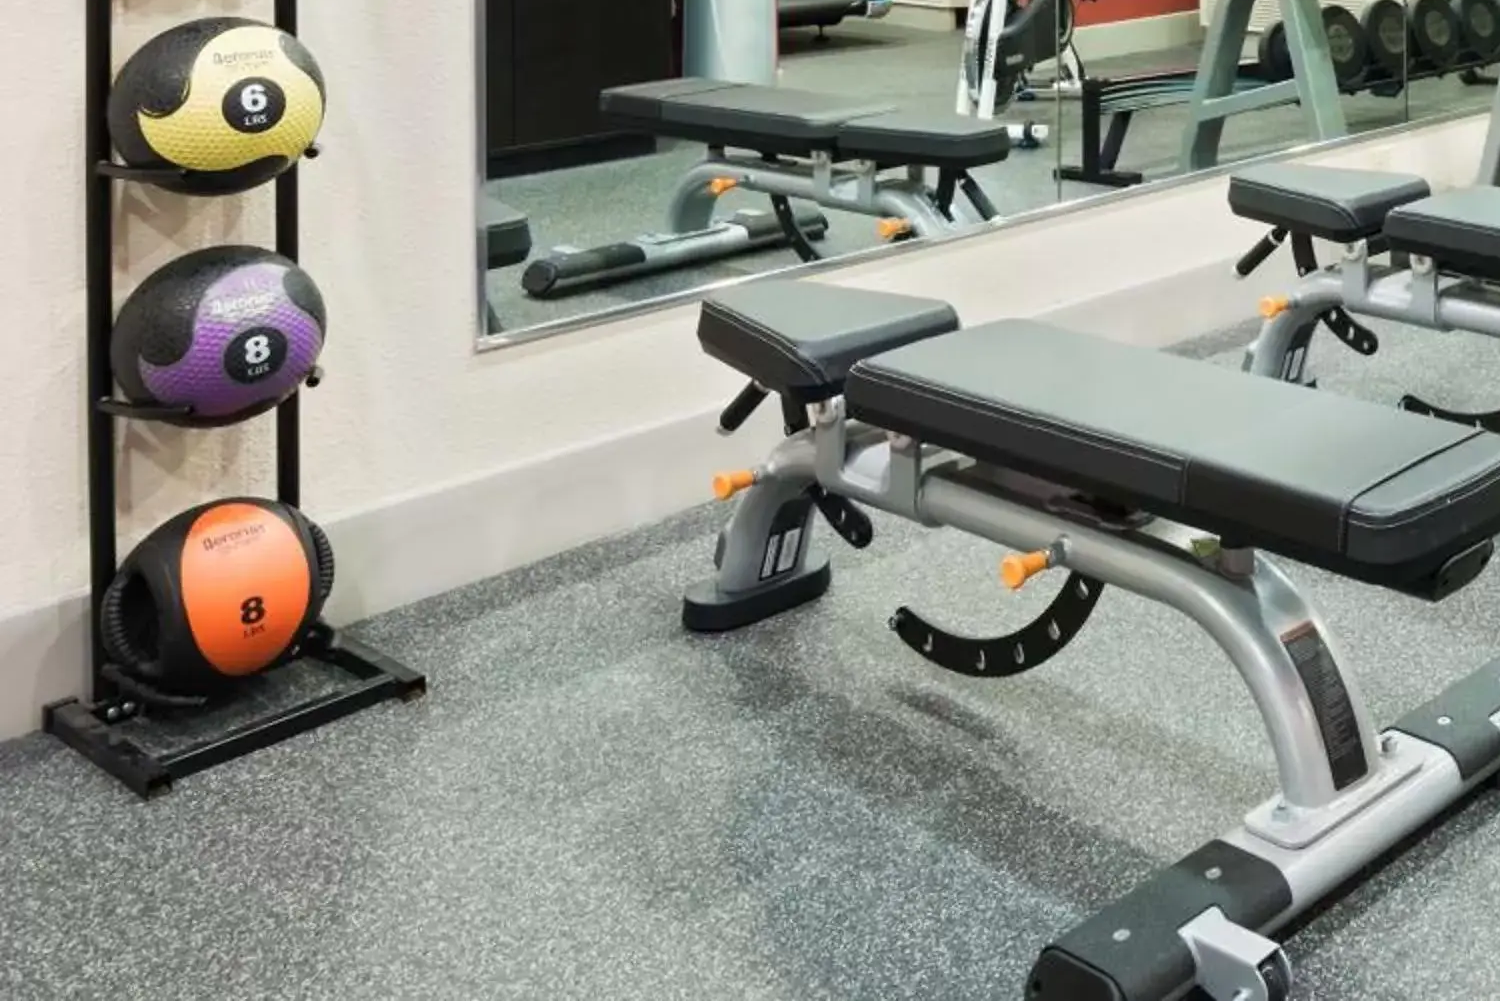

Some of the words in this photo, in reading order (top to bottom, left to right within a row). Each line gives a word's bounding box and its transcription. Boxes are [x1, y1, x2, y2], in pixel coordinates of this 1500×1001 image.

[241, 84, 267, 113] 6
[244, 334, 271, 364] 8
[240, 595, 266, 625] 8
